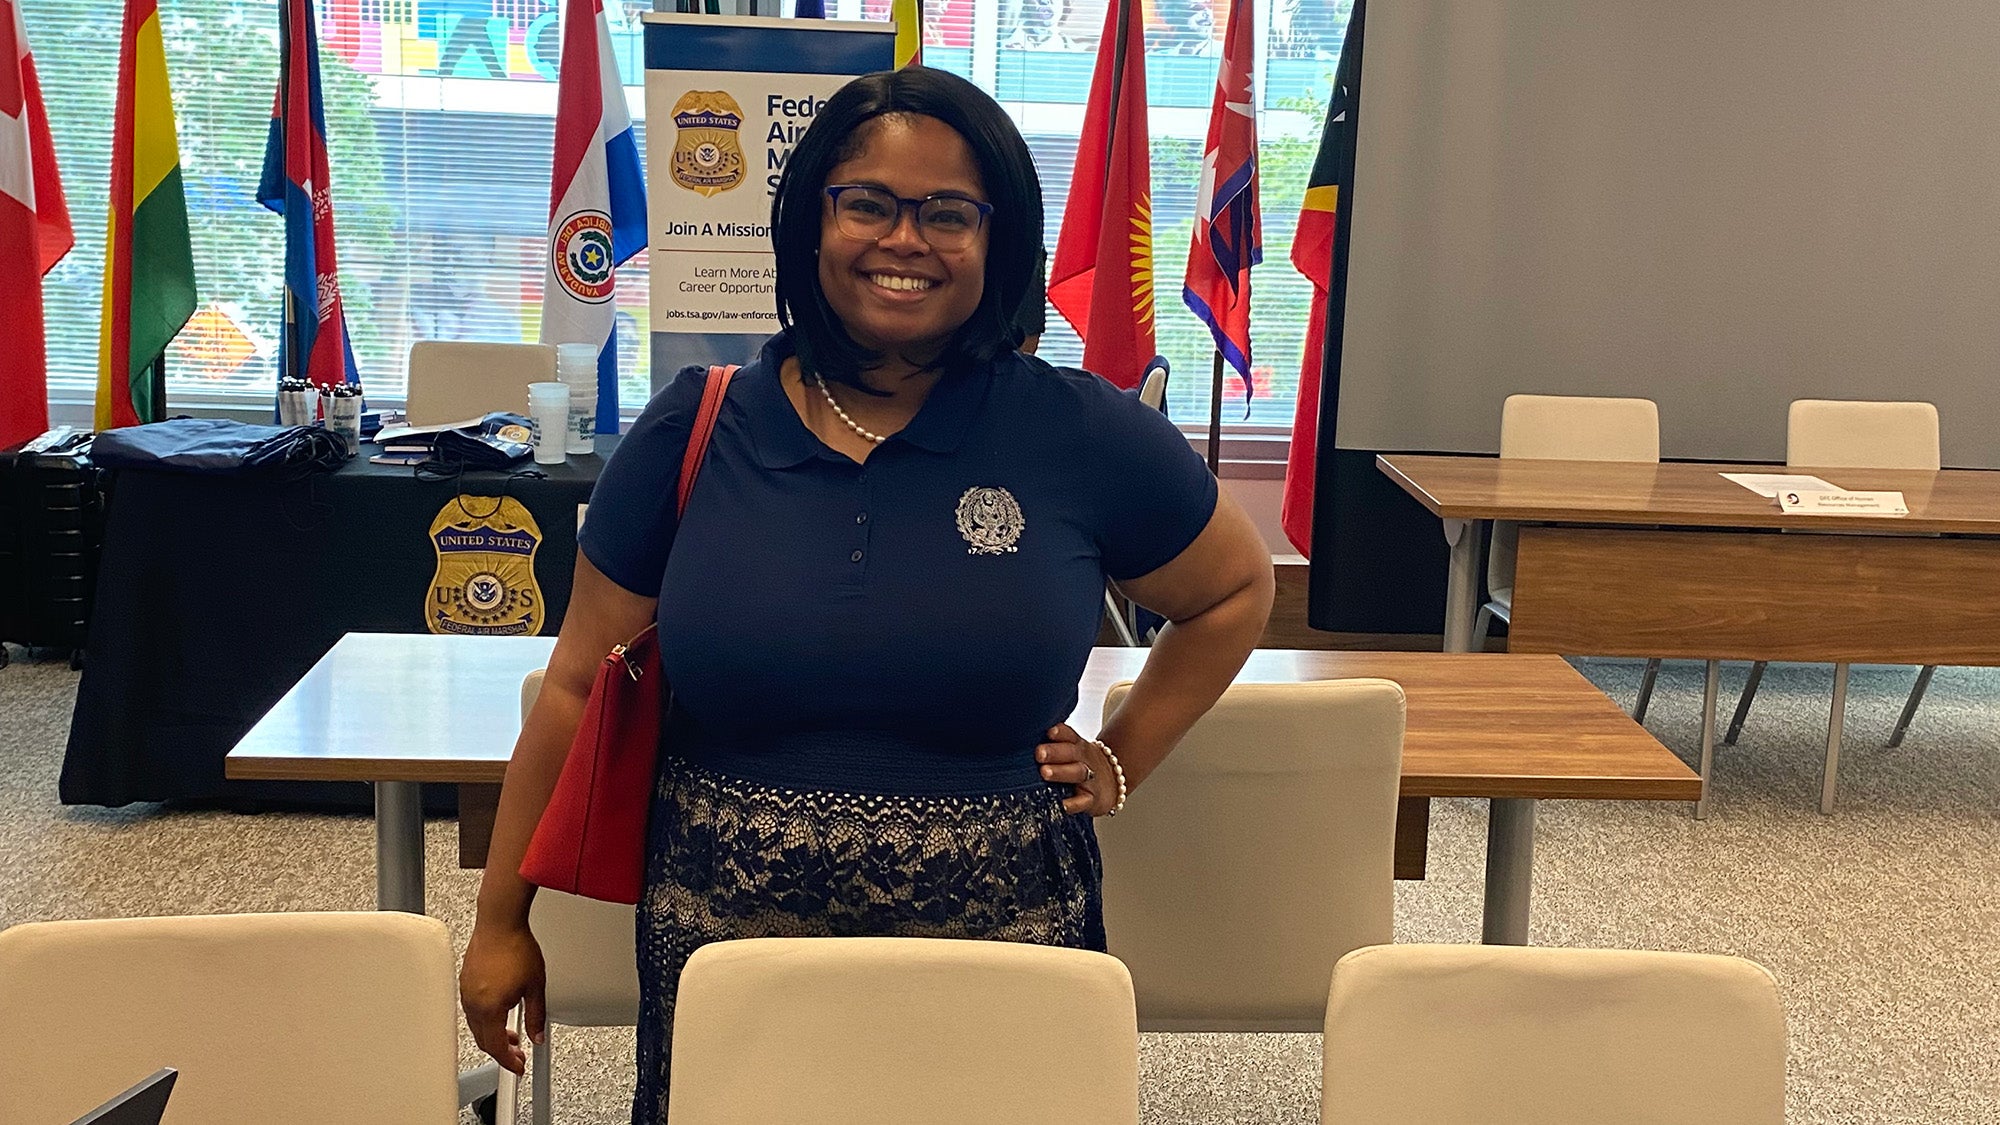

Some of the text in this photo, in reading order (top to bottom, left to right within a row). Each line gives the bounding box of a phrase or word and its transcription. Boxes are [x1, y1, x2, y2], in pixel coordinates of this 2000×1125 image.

[767, 95, 828, 117] Fede
[677, 117, 738, 126] UNITED STATES
[766, 121, 806, 143] Air
[676, 152, 740, 165] U S
[665, 222, 698, 236] Join
[701, 223, 714, 236] A
[694, 267, 777, 279] Learn More Ab
[679, 281, 775, 294] Career Opportun
[666, 310, 779, 320] jobs.tsa.gov/law-enforce
[440, 535, 532, 549] UNITED STATES
[436, 587, 534, 608] U S
[442, 621, 476, 634] FEDERAL
[491, 623, 528, 635] MARSHAL
